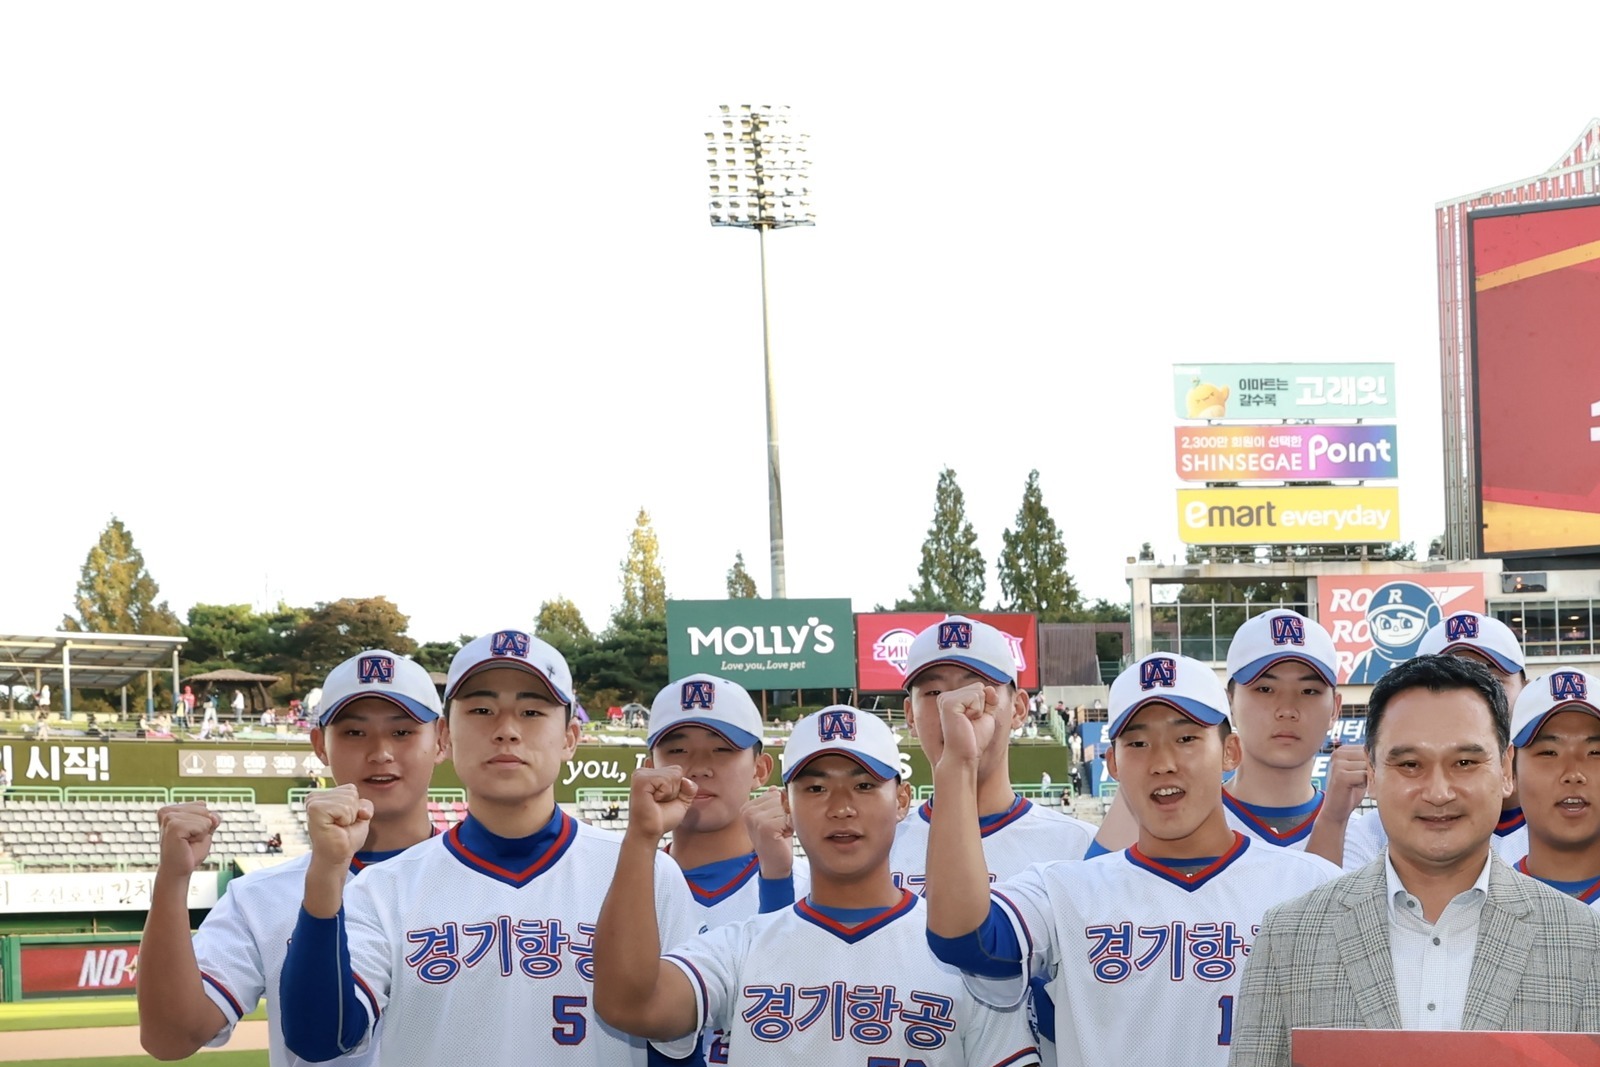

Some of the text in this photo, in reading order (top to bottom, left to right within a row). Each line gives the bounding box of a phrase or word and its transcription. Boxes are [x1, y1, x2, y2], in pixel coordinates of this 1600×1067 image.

[1295, 376, 1389, 406] 고래잇
[1181, 436, 1302, 449] 2,300만 회원이 선택한
[1309, 434, 1392, 470] Point
[1181, 453, 1302, 471] SHINSEGAE
[1185, 501, 1391, 530] emart everyday
[687, 617, 835, 656] MOLLY'S
[721, 660, 806, 672] Love you, Love pet
[26, 745, 110, 781] 시작!
[562, 760, 627, 785] you,
[78, 949, 128, 987] NO
[1086, 921, 1260, 983] 경기항
[553, 996, 586, 1044] 5
[743, 982, 956, 1050] 경기항공
[1218, 995, 1233, 1045] 1
